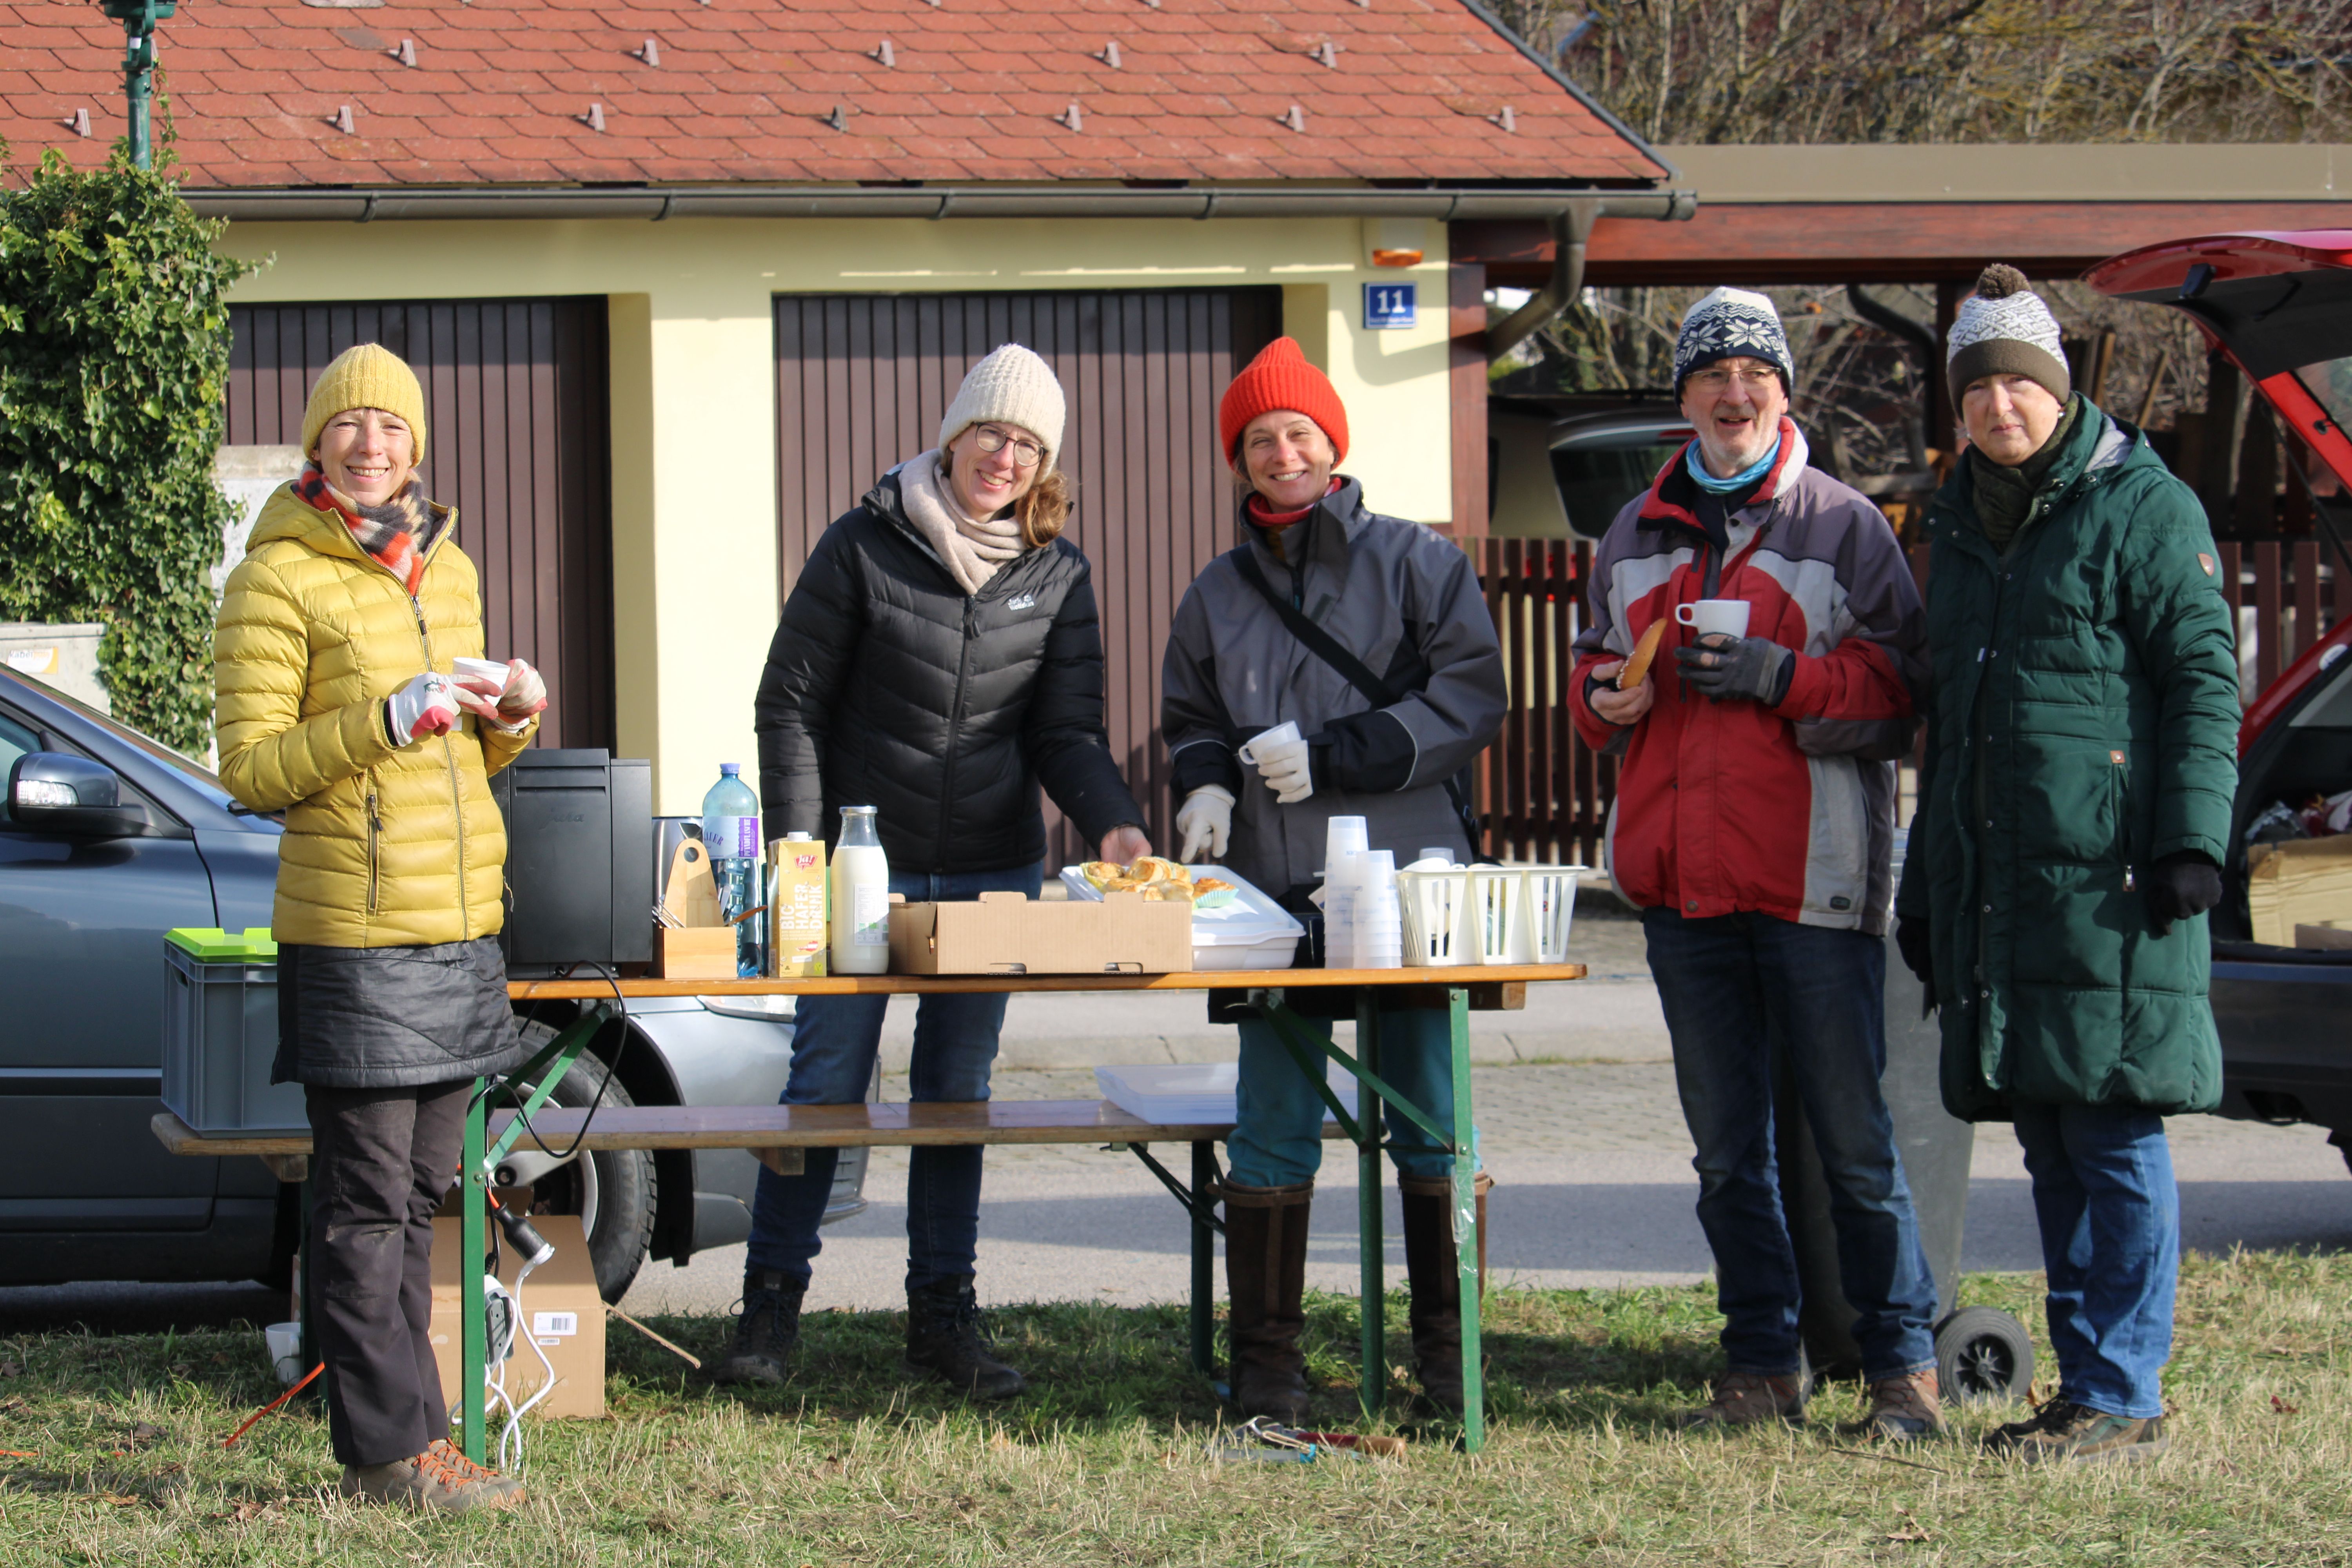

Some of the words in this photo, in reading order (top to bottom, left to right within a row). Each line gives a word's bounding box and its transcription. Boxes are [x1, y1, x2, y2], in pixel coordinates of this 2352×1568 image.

[1377, 290, 1406, 313] 11
[780, 905, 795, 929] BIO
[795, 884, 809, 929] HAFER
[809, 884, 822, 929] DRINK
